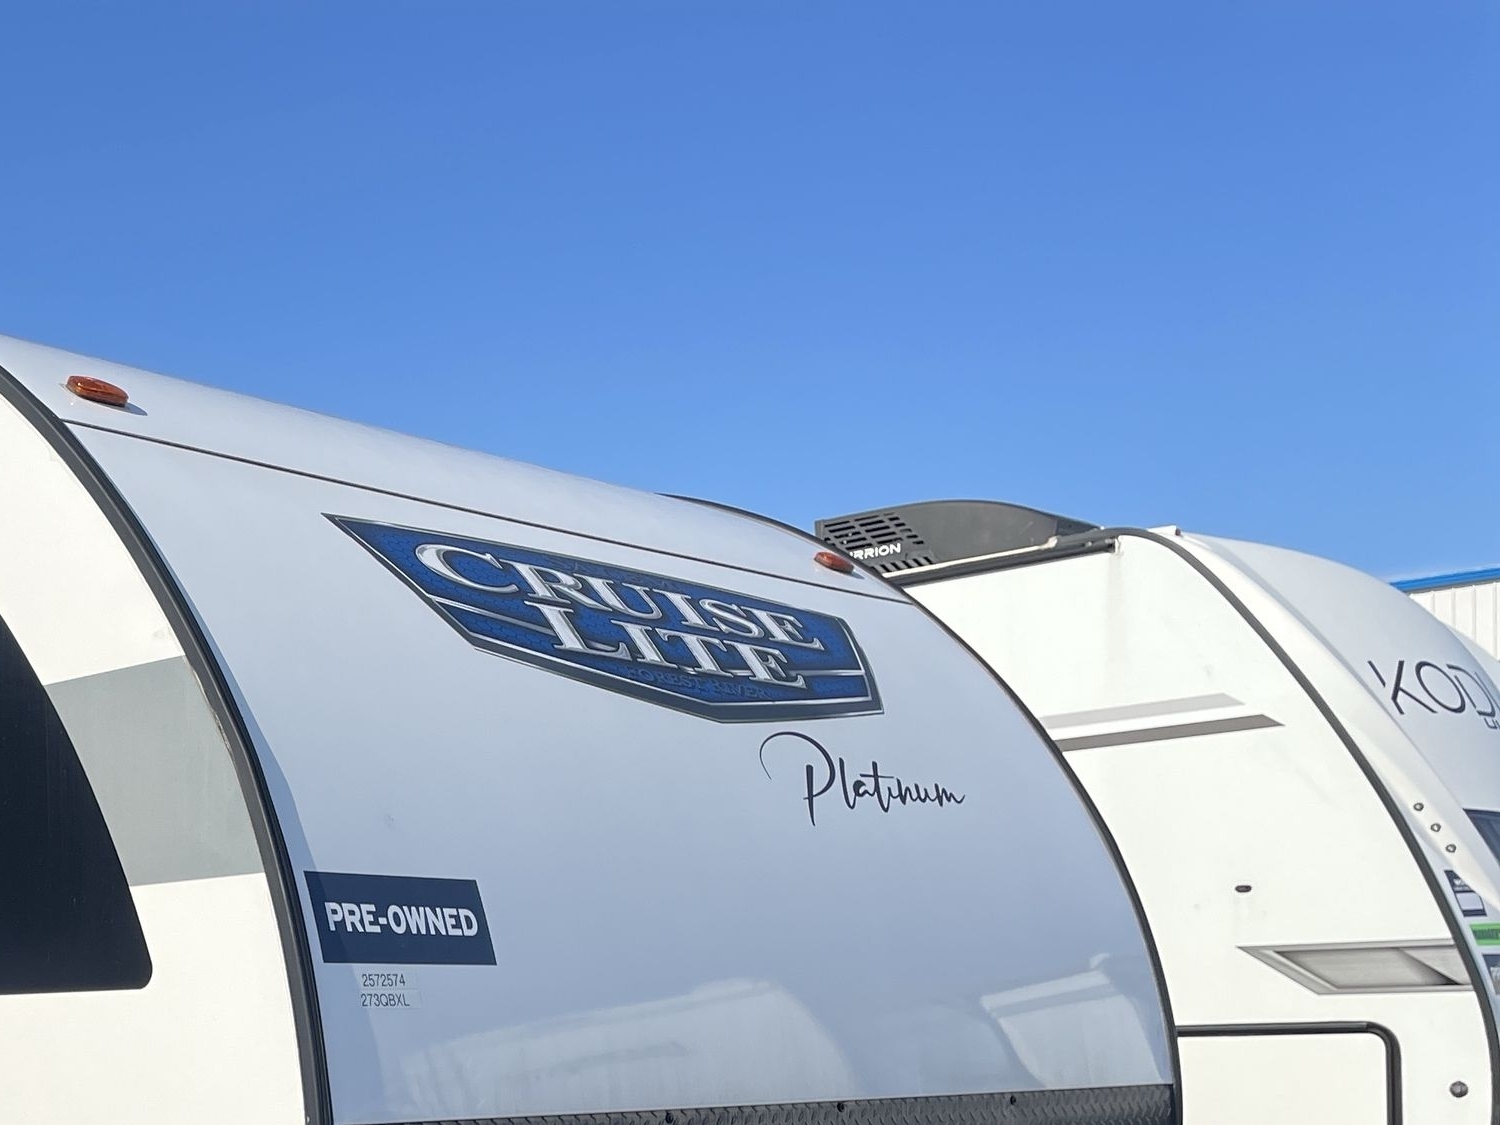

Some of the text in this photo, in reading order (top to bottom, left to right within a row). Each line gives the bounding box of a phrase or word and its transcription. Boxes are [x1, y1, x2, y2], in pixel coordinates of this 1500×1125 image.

[849, 543, 901, 560] RRION
[415, 543, 825, 651] CRUISE
[524, 601, 807, 690] LITE
[627, 667, 705, 692] FOREST
[759, 731, 966, 826] Platinum
[324, 902, 479, 937] PRE-OWNED
[361, 973, 406, 988] 2572574
[360, 993, 411, 1008] 273QBXL
